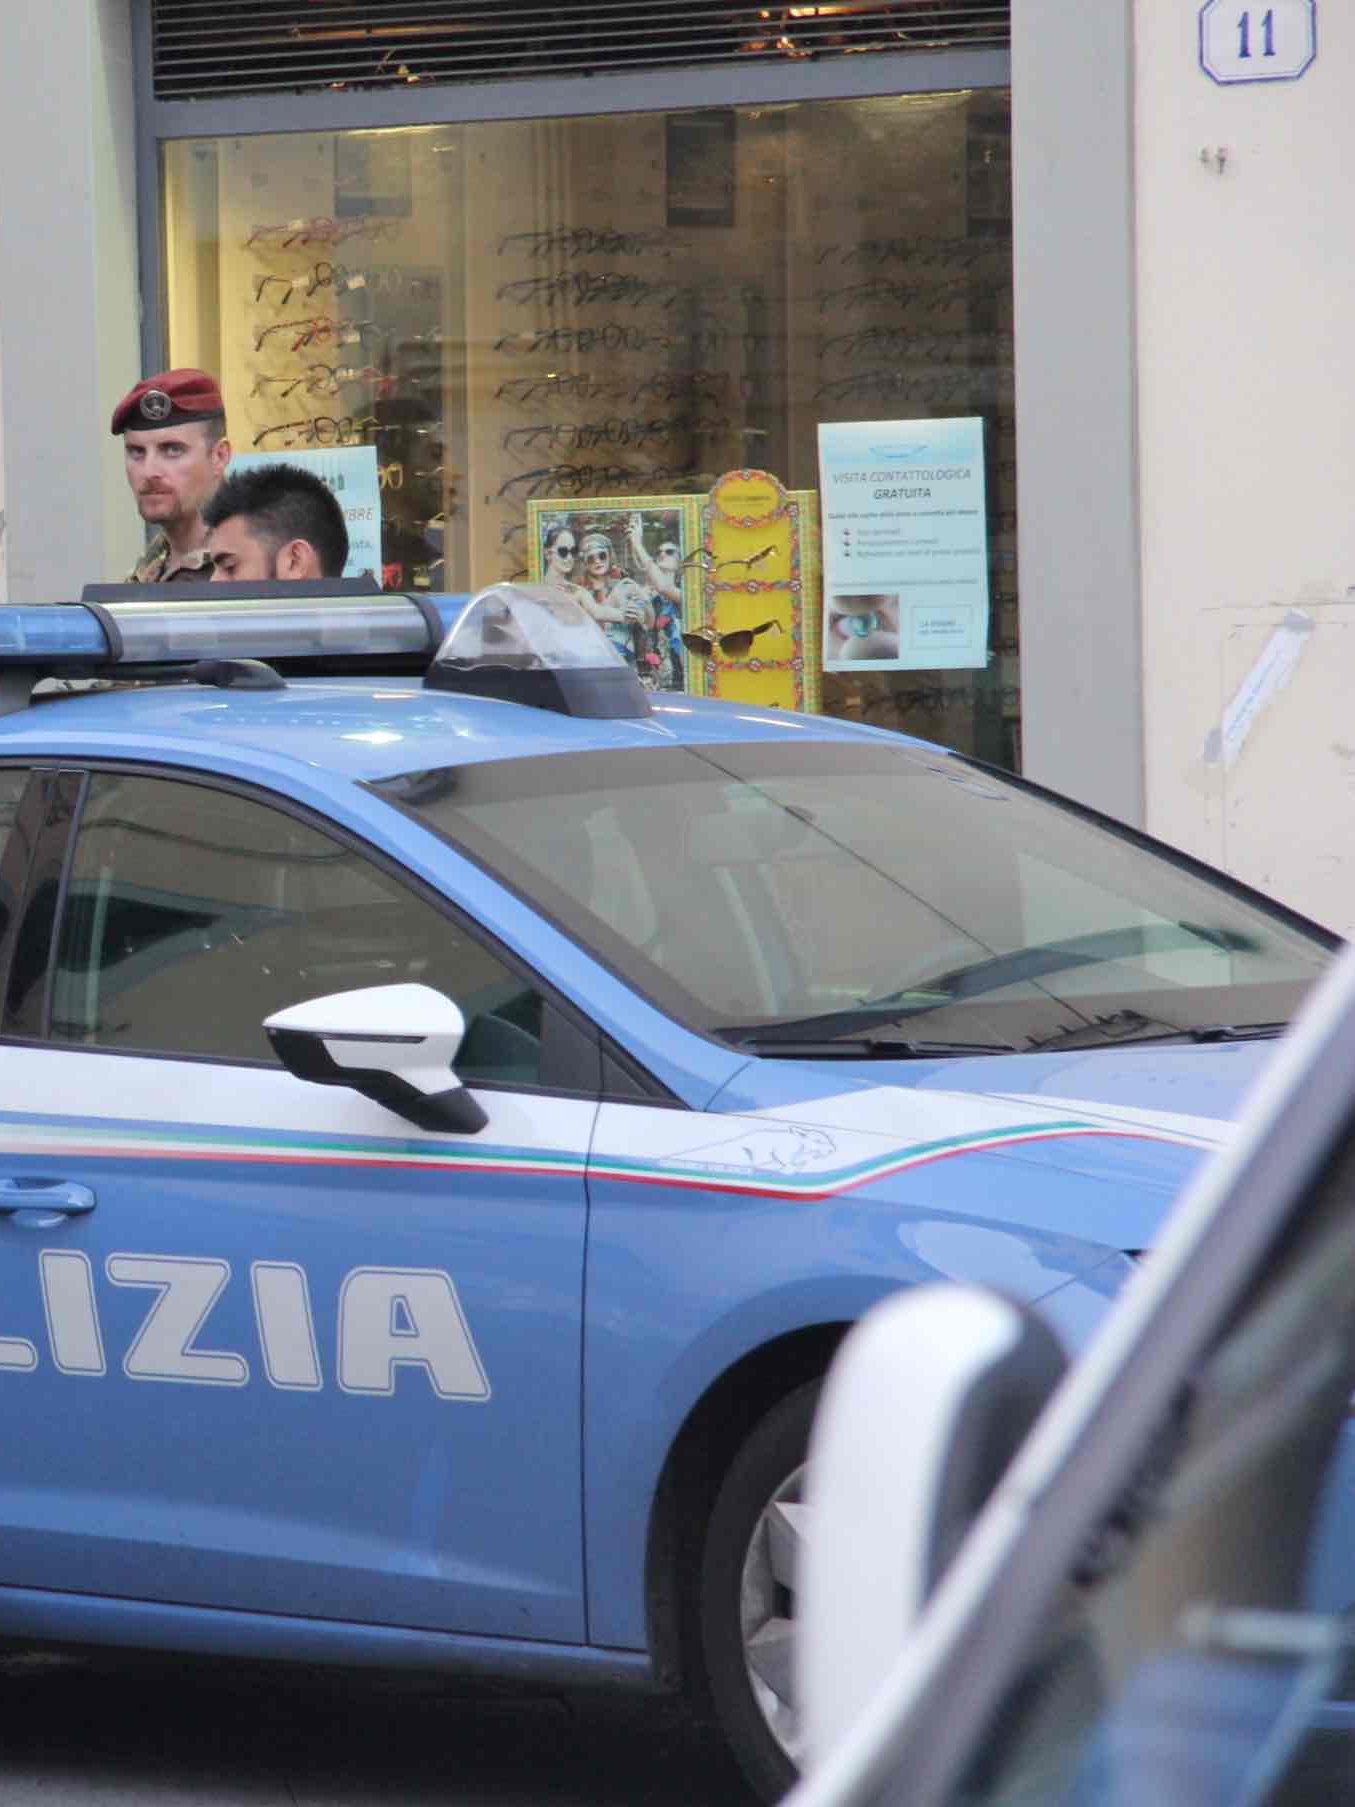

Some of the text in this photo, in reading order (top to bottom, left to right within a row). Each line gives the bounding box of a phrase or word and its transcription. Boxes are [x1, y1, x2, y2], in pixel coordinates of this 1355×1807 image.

[1236, 8, 1277, 59] 11
[833, 468, 972, 484] VISITA CONTATTOLOGICA
[873, 487, 933, 500] GRATUITA
